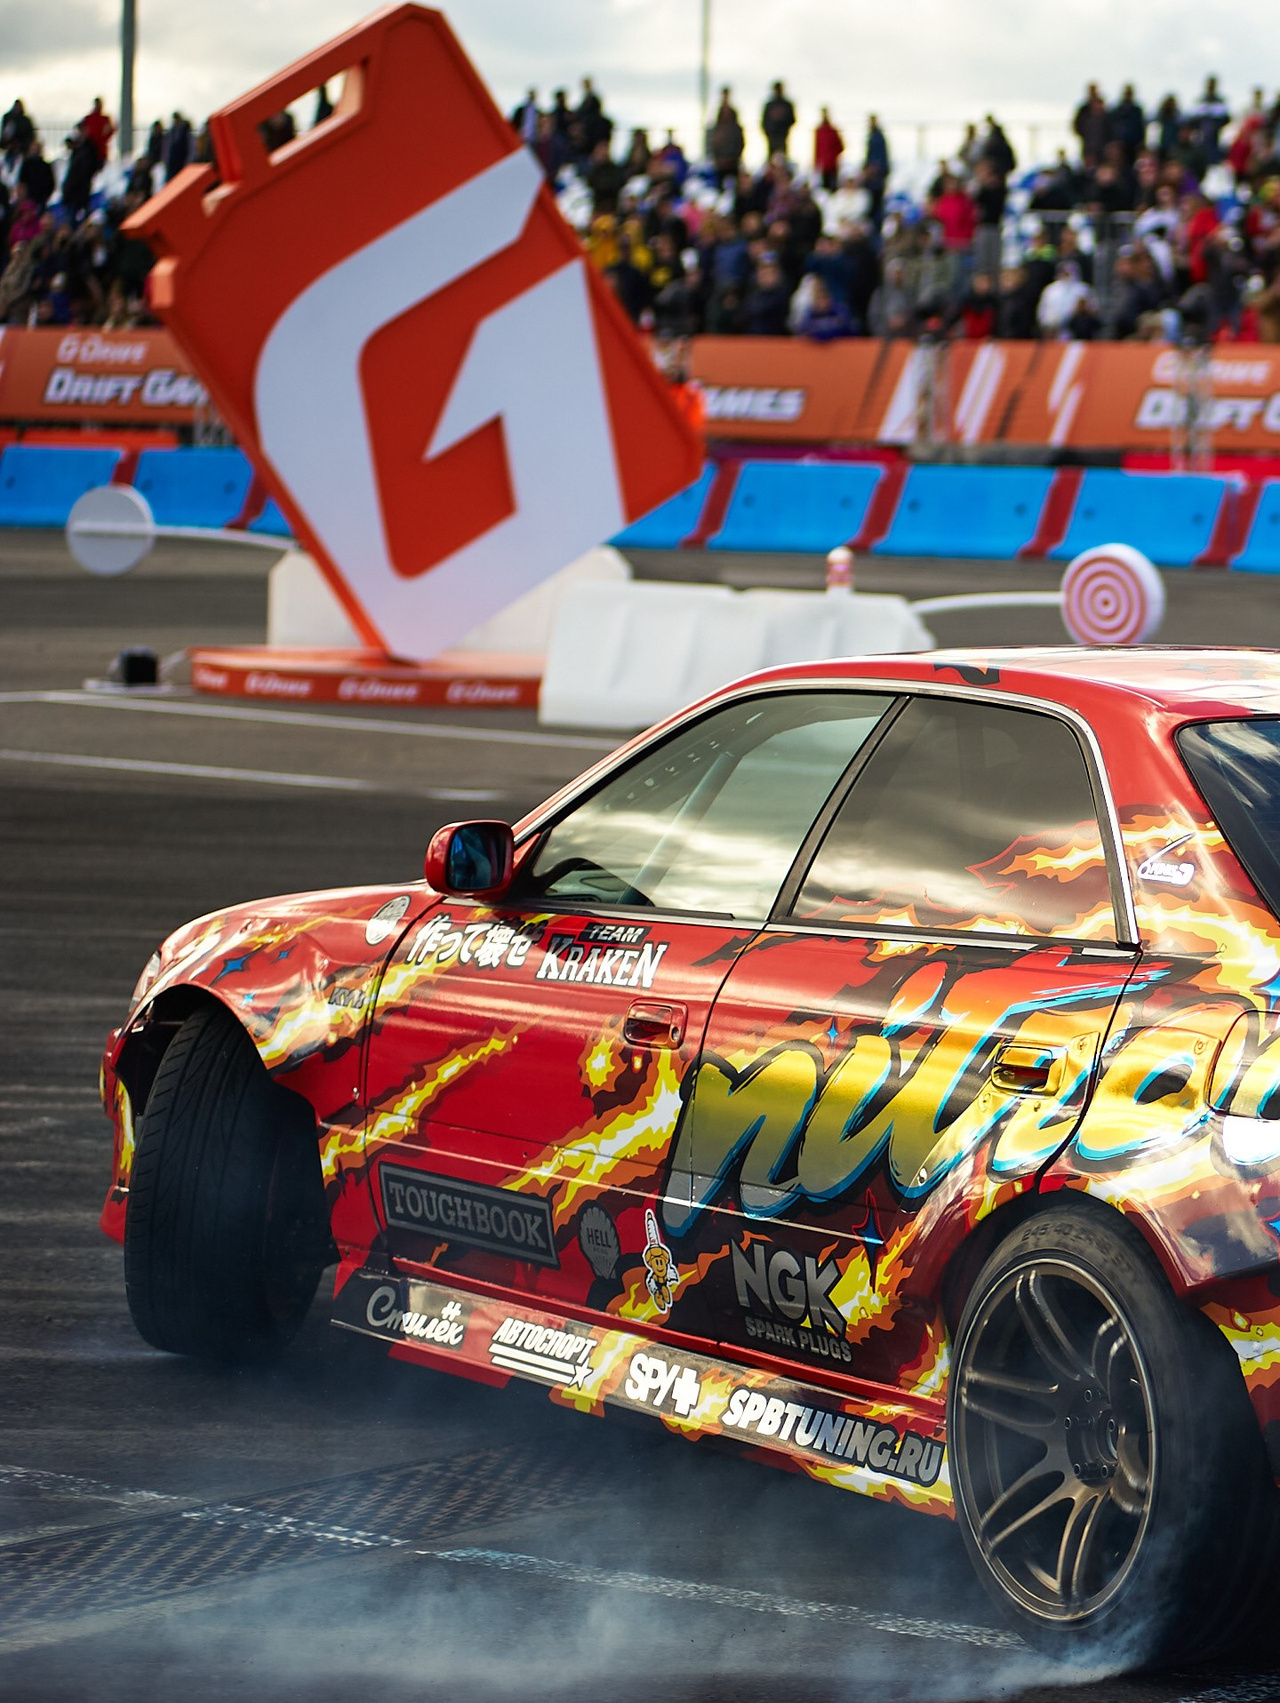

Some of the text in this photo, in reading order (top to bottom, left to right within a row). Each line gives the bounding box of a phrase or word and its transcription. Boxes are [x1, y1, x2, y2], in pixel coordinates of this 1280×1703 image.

[590, 924, 643, 944] TEAM
[536, 934, 669, 988] KRAKEN
[388, 1180, 547, 1249] TOUGHBOOK
[587, 1227, 612, 1248] HELL
[731, 1238, 848, 1334] NGK
[492, 1317, 598, 1364] АВТОСПОРТ
[747, 1317, 852, 1363] SPARK PLUGS
[720, 1388, 944, 1483] SPBTUNING.RU
